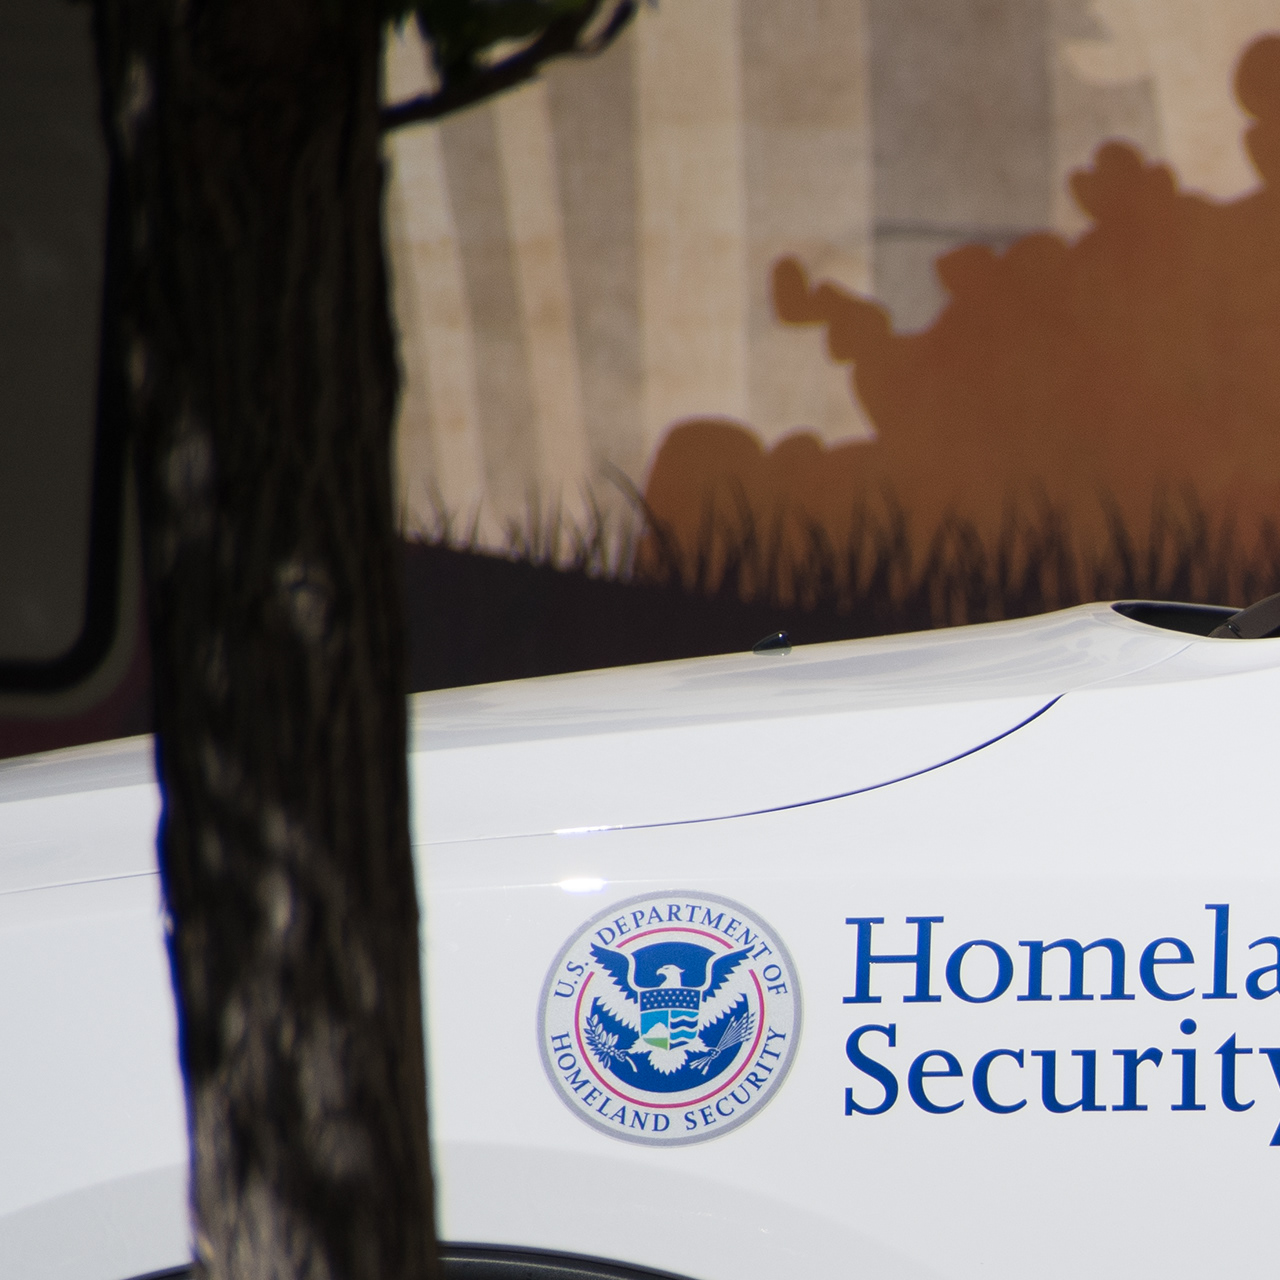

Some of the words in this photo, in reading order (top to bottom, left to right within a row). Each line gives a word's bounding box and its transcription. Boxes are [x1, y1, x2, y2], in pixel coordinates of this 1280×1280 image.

[554, 960, 589, 999] U.S.
[596, 903, 772, 962] DEPARTMENT
[762, 963, 789, 996] OF
[551, 1031, 670, 1132] HOMELAND
[684, 1026, 787, 1131] SECURITY
